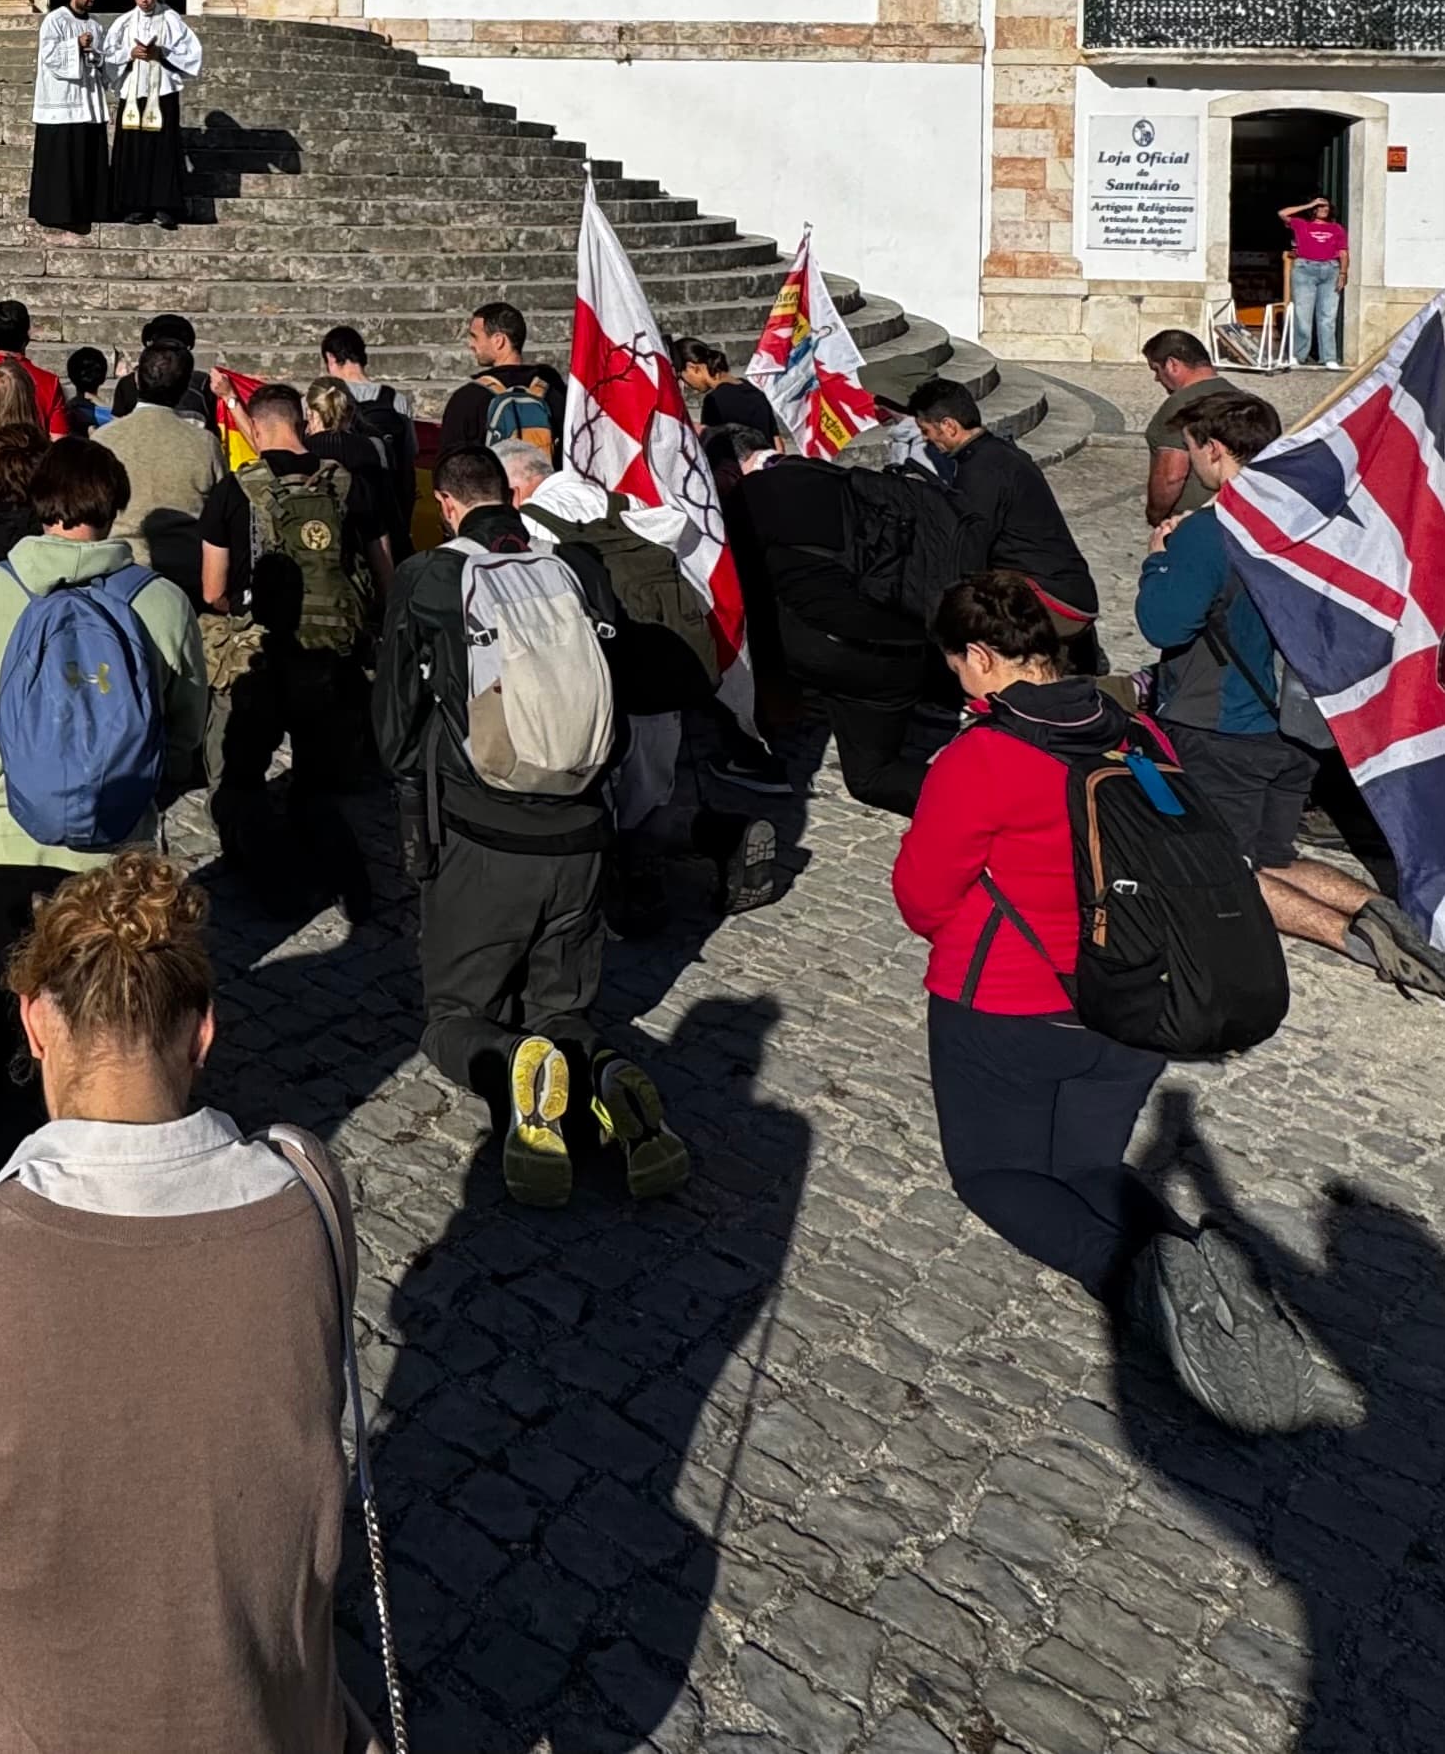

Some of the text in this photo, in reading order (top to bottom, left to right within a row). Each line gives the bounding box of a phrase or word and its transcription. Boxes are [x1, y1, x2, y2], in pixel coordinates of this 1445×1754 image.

[1097, 151, 1190, 167] Loja Oficial
[1136, 168, 1149, 177] do
[1105, 178, 1181, 192] Santuário
[1090, 202, 1194, 215] Artigos Religiosos
